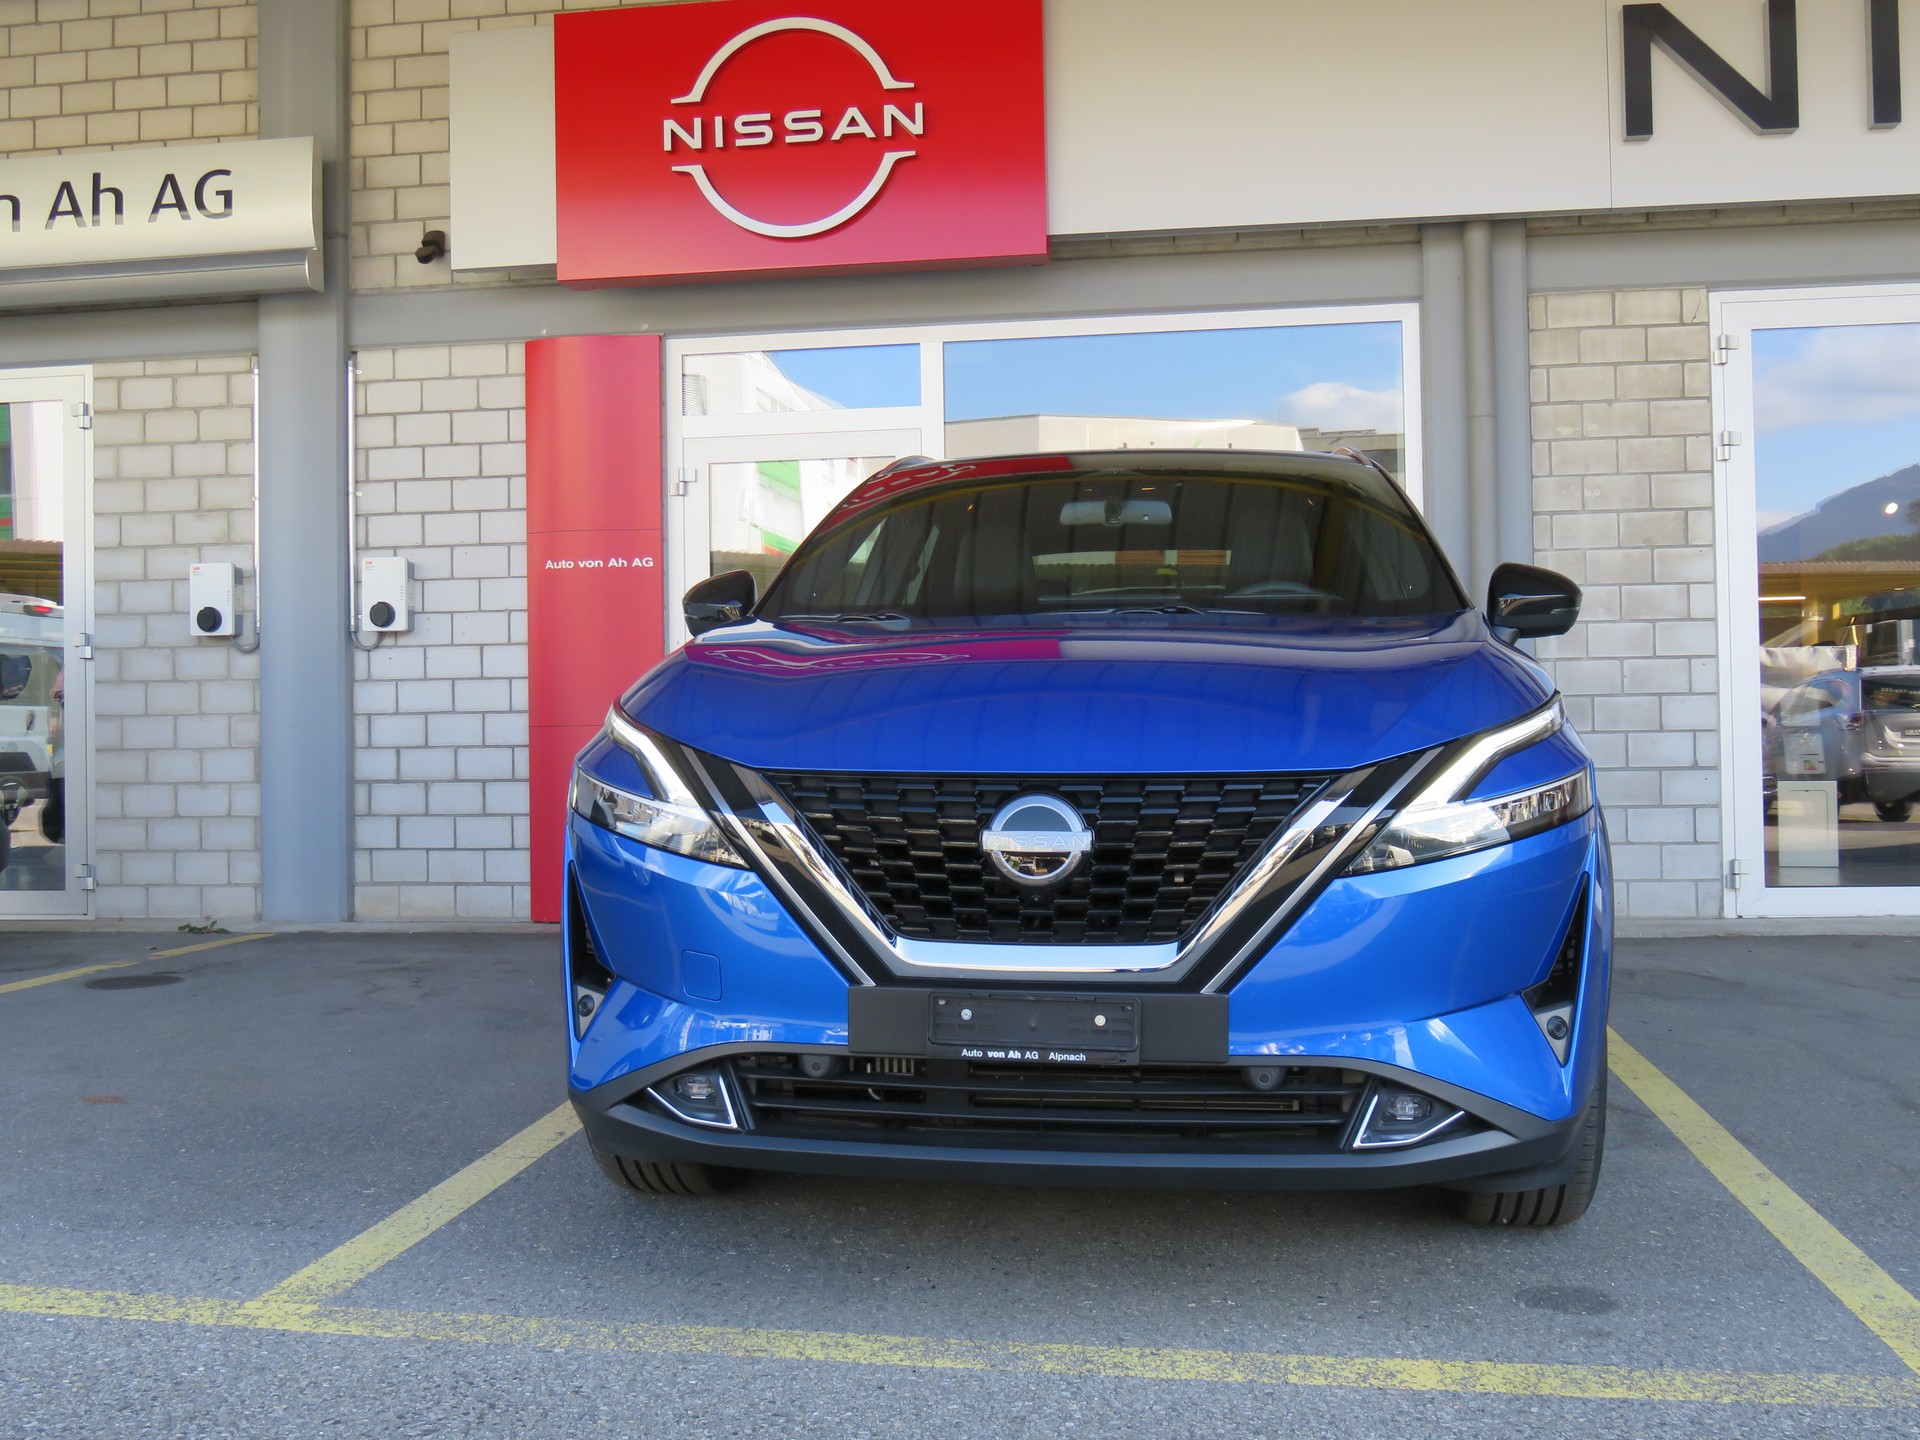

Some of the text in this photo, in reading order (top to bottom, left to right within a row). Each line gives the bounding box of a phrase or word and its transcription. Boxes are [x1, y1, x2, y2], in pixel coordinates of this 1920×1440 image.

[663, 102, 924, 151] NISSAN
[44, 172, 125, 230] Ah
[148, 169, 234, 224] AG
[545, 557, 654, 569] Auto von Ah AG
[987, 835, 1087, 848] NISSAN
[961, 1048, 1087, 1062] Auto von Ah AG Alpnach
